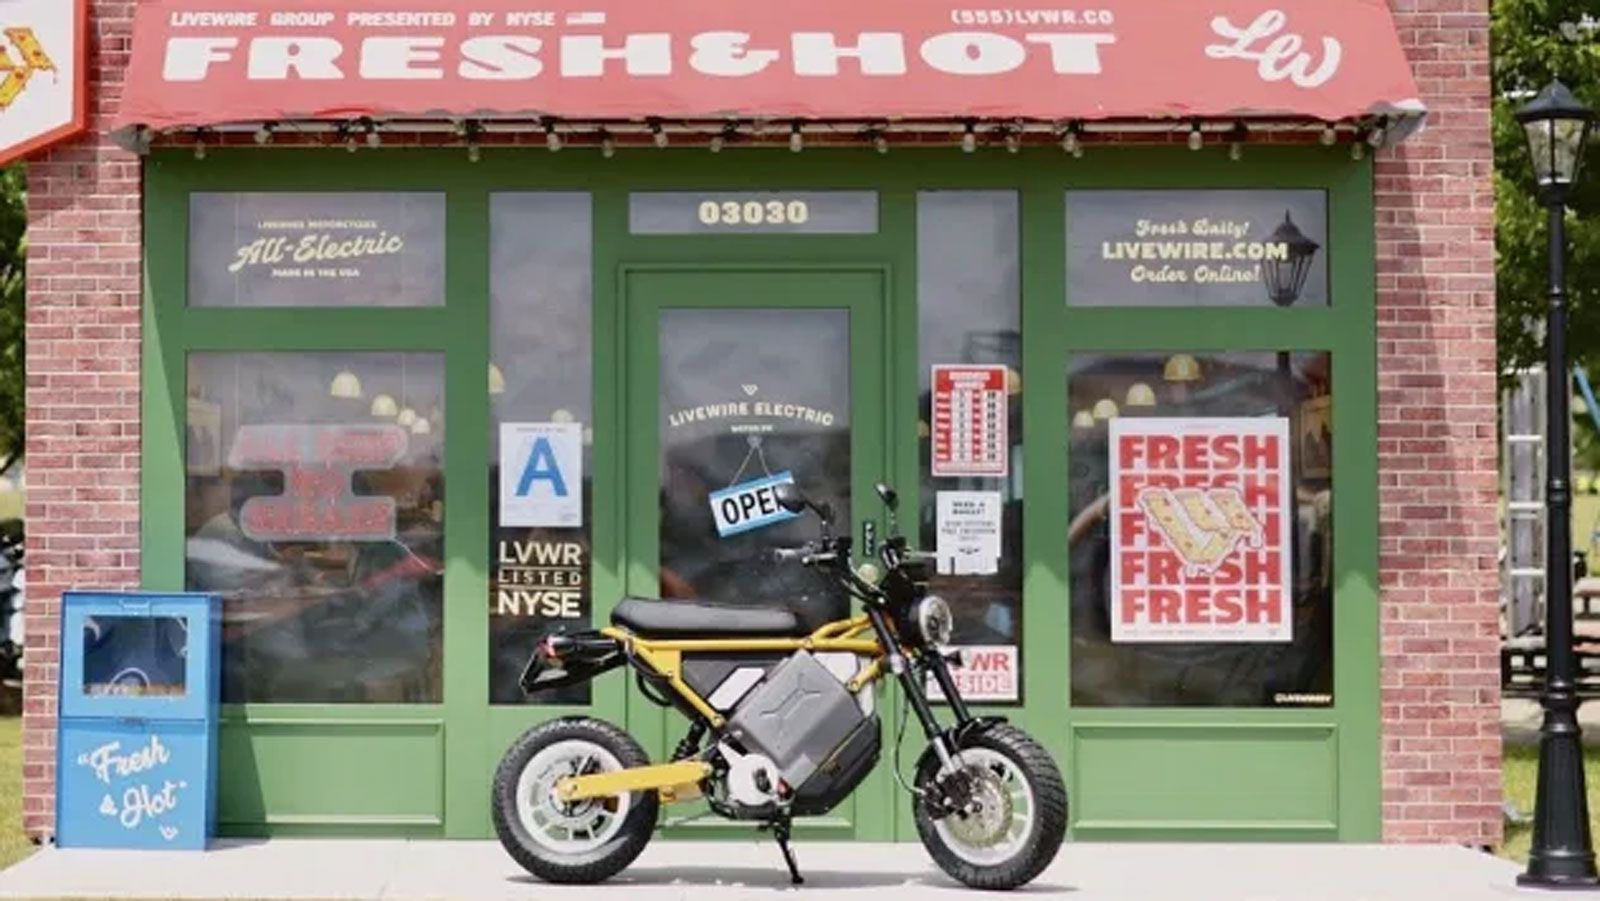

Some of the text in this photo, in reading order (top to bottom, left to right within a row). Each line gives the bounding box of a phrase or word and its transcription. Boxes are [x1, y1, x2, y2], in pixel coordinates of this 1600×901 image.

[171, 12, 555, 26] LIVEWIRE GROUP PRESENTED BY NYSE
[699, 201, 808, 224] 03030
[1136, 218, 1251, 239] Fresh Daily!
[228, 231, 404, 272] All-Electric
[1102, 241, 1288, 260] LIVEWIRE.COM
[1131, 264, 1261, 283] Order Online!
[668, 402, 834, 427] LIVEWIRE ELECTRIC
[1119, 435, 1279, 469] FRESH
[515, 436, 568, 496] A
[500, 541, 582, 565] LVWR
[498, 572, 582, 586] LISTED
[498, 592, 581, 617] NYSE
[1121, 589, 1281, 624] FRESH
